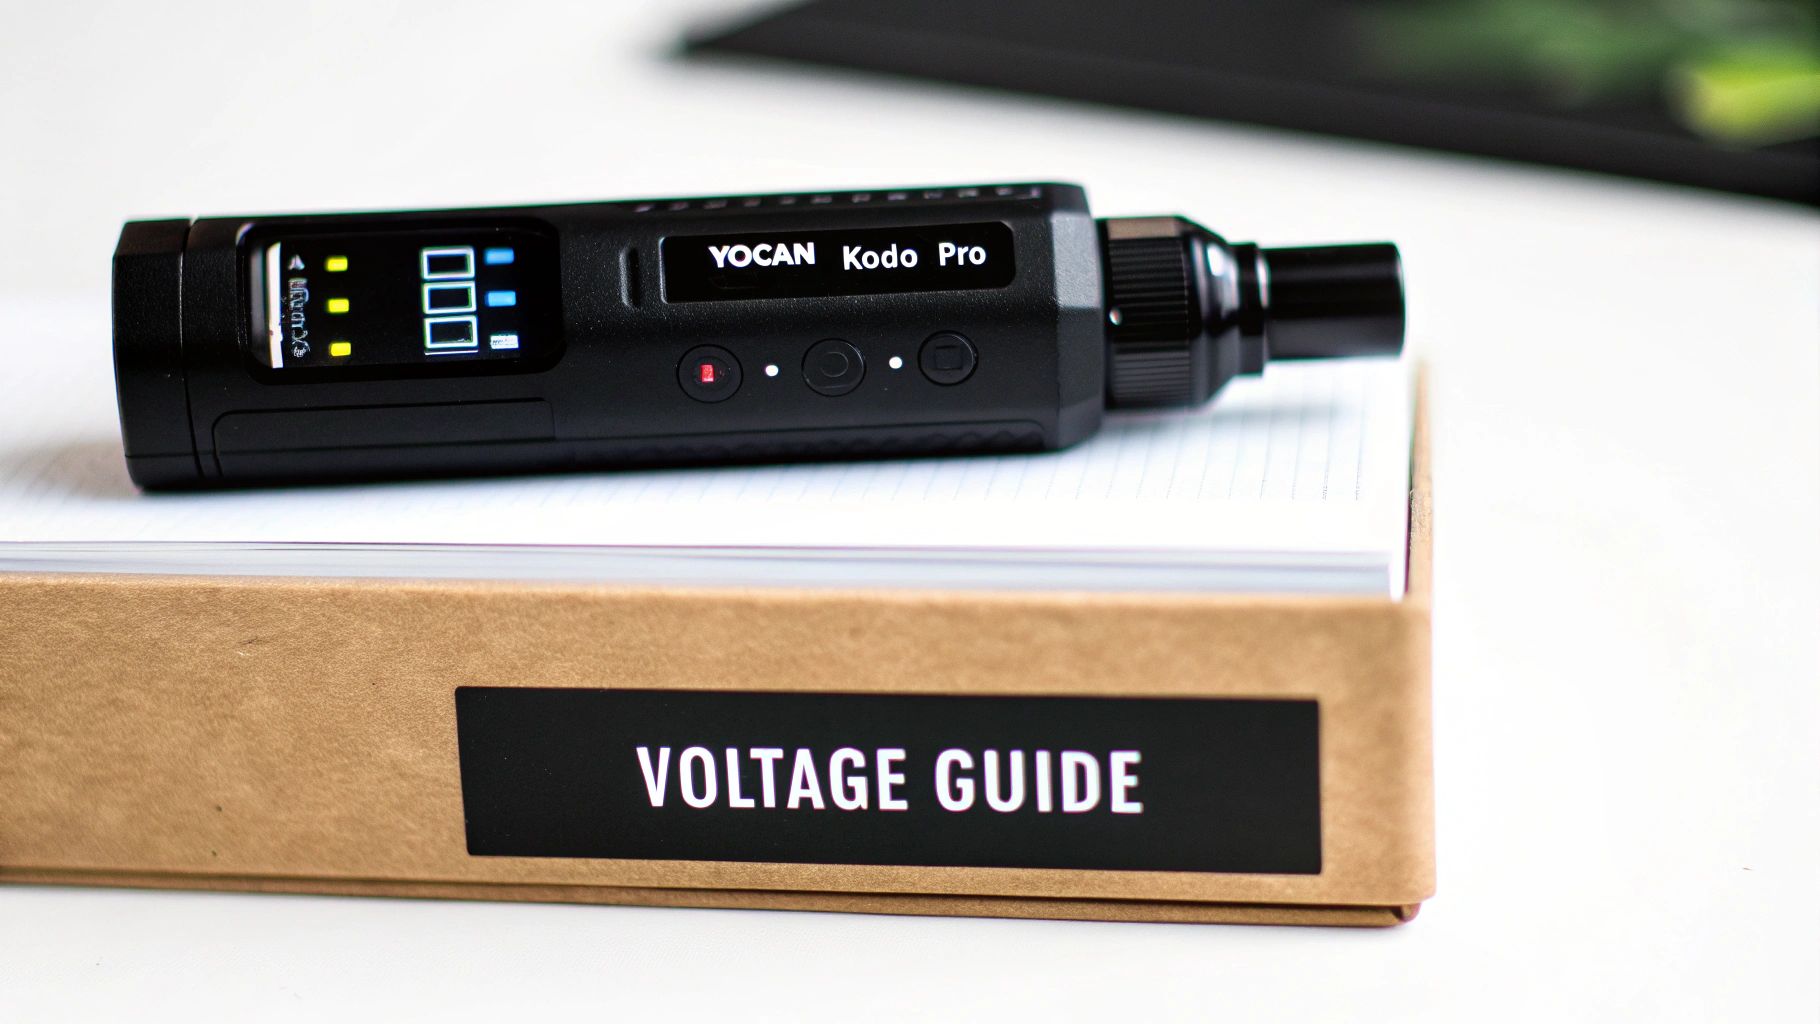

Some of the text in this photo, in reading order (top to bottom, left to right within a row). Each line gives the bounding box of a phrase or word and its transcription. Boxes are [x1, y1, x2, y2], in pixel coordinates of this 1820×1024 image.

[708, 241, 987, 271] YOCAN Kodo Pro
[635, 746, 1144, 814] VOLTAGE GUIDE
